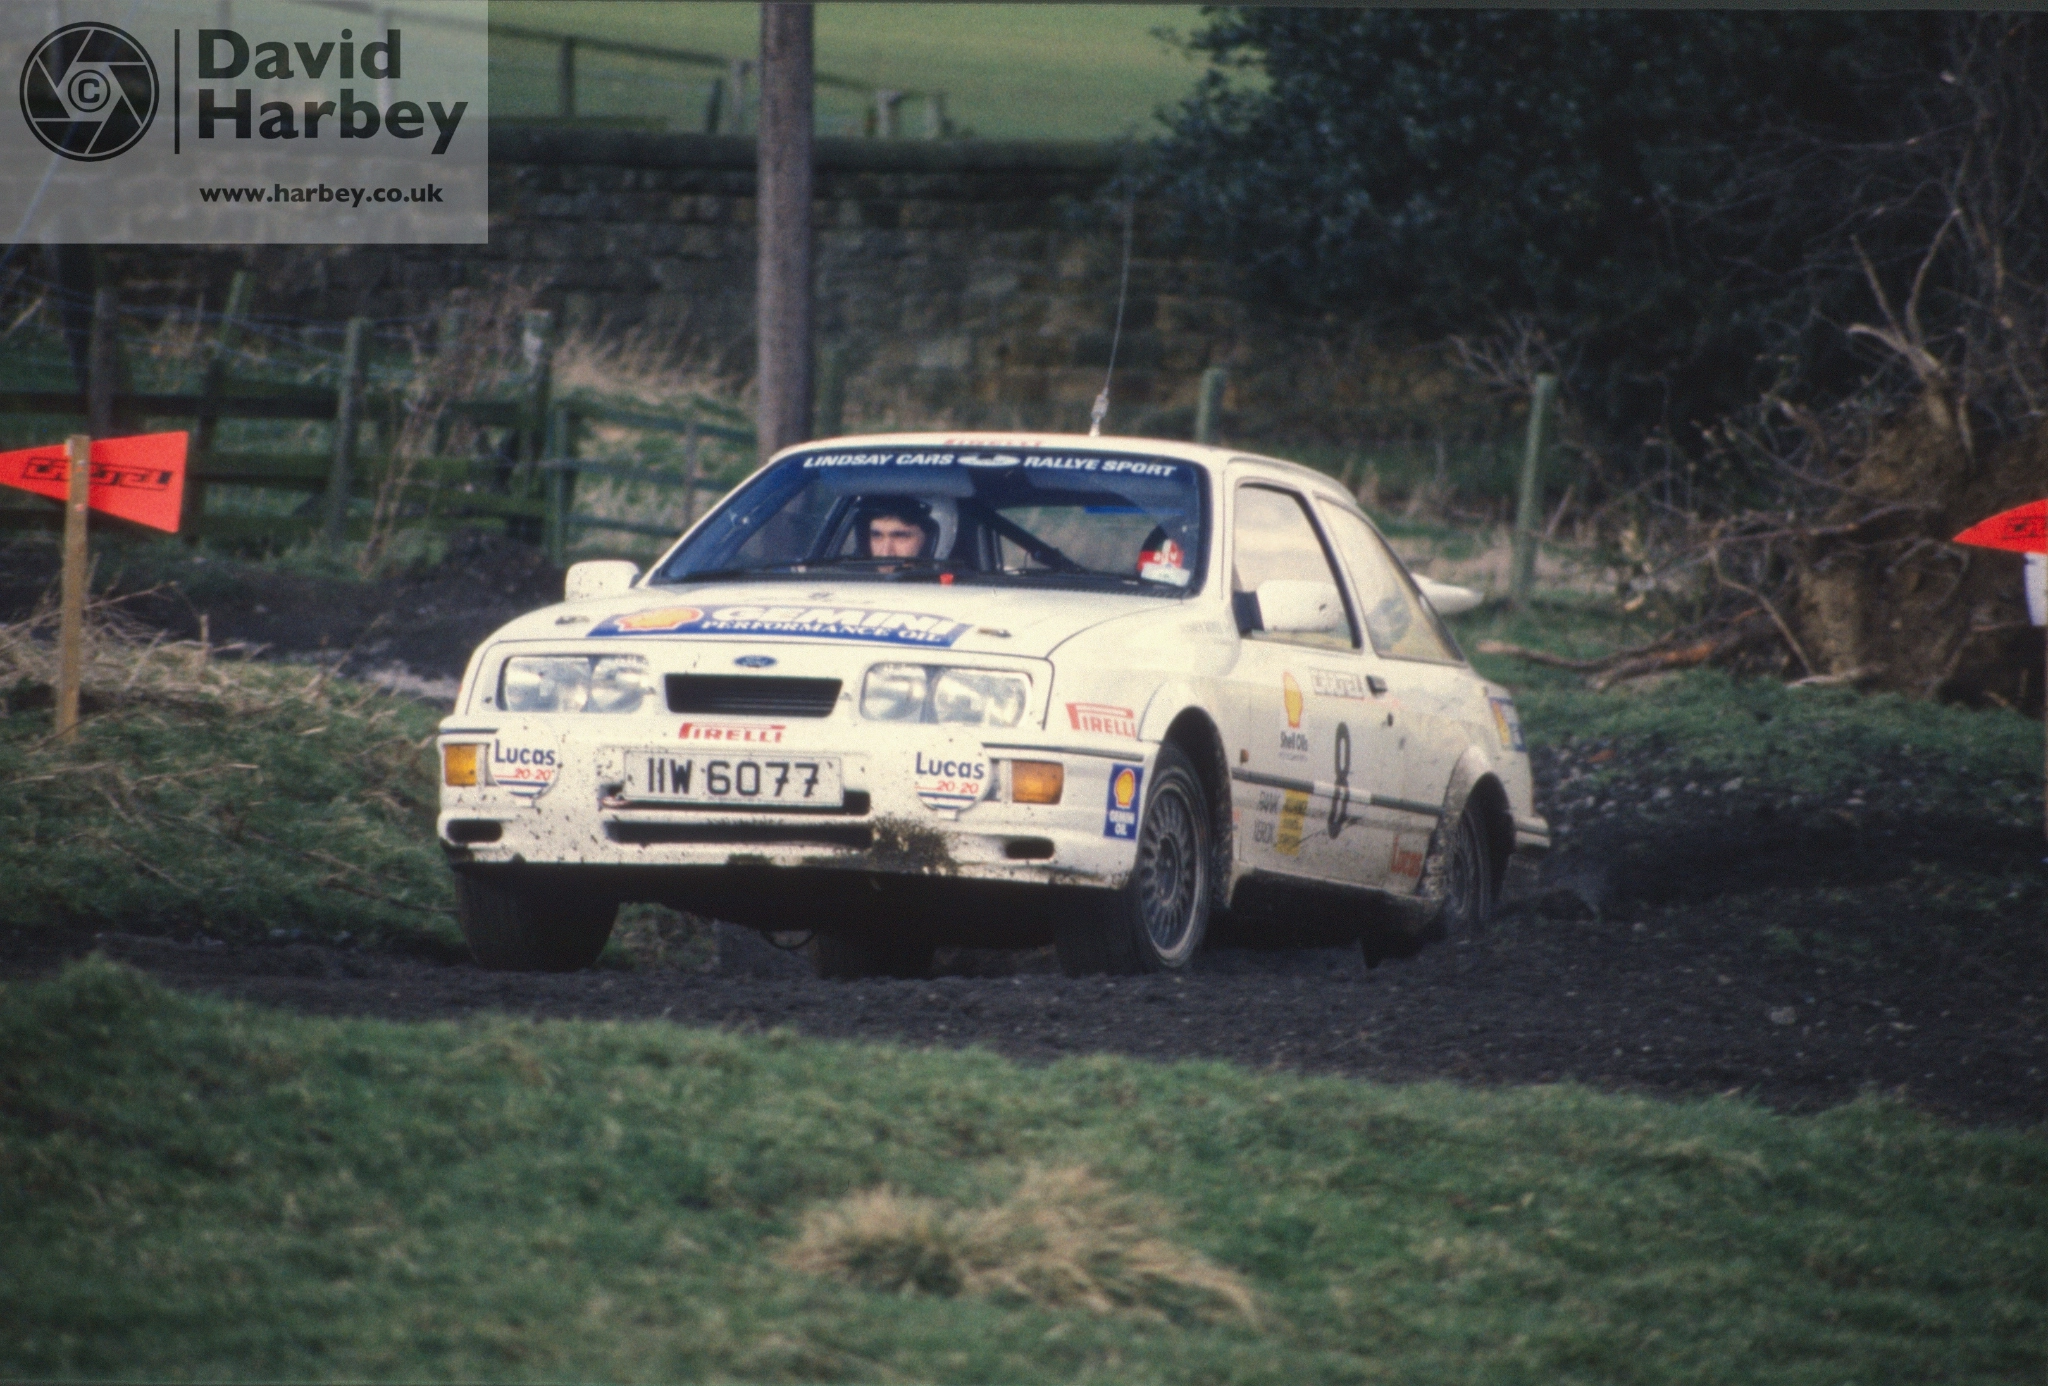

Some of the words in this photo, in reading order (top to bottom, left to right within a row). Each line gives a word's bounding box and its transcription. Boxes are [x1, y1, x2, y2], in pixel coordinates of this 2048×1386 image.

[803, 453, 893, 468] LINDSAY
[896, 453, 955, 466] CARS
[1023, 456, 1099, 470] RALLYE
[1101, 459, 1177, 477] SPORT
[701, 620, 891, 637] PERFORMANCE
[898, 629, 942, 643] OIL
[712, 606, 958, 636] GEMINI
[678, 722, 786, 743] PIRELLI
[1065, 702, 1137, 739] PIRELLI
[495, 739, 555, 766] Lucas
[916, 751, 985, 780] Lucas
[706, 759, 820, 798] 6077
[1327, 721, 1351, 840] 8
